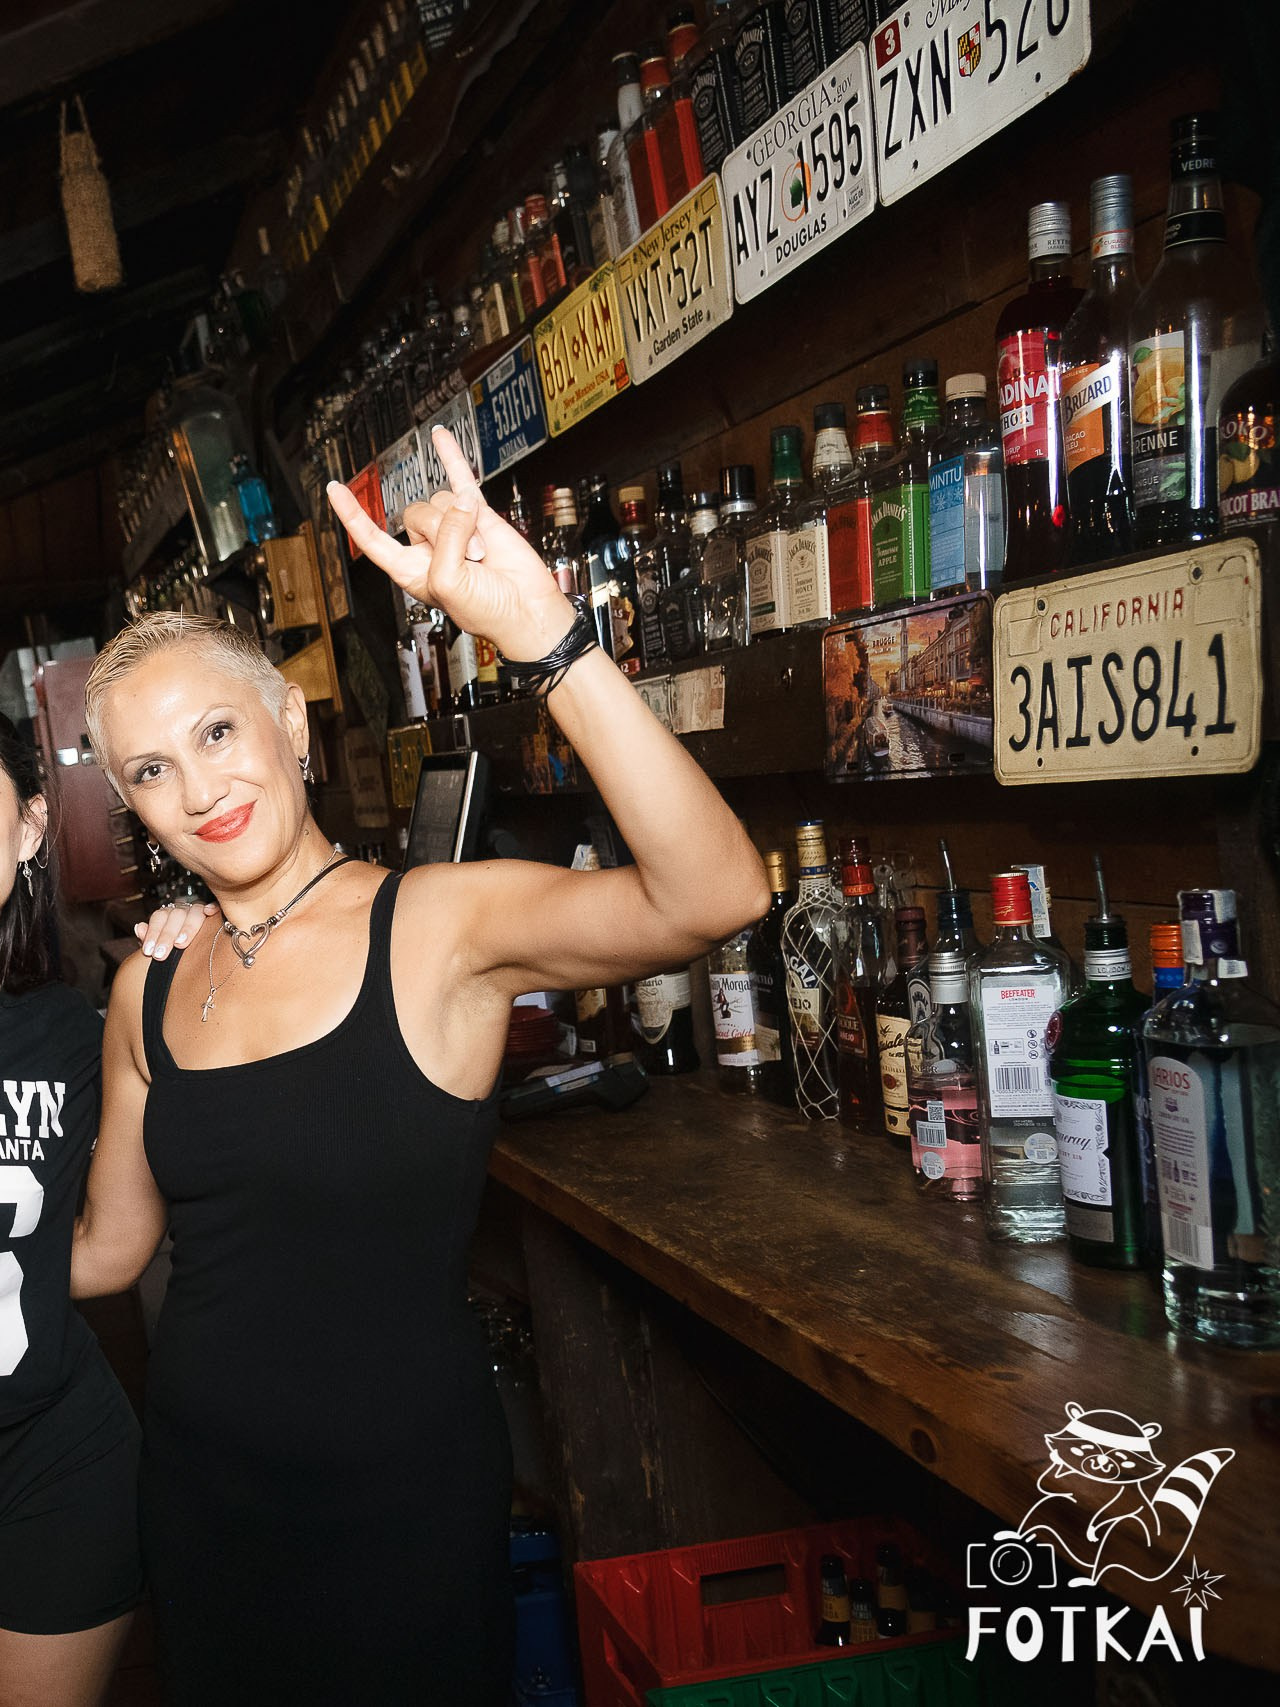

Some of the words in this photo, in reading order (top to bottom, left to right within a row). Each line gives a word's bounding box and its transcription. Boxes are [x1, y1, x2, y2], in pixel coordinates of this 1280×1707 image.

[883, 27, 897, 56] 3
[880, 27, 953, 161] ZXN
[733, 167, 779, 267] AYZ
[796, 90, 865, 215] 1595
[638, 235, 664, 267] New
[660, 209, 694, 258] Jersey
[776, 212, 828, 264] DOUGLAS
[626, 260, 668, 343] VXT
[670, 218, 717, 310] 52T
[541, 326, 576, 402] 861
[576, 286, 619, 373] KAM
[652, 329, 681, 358] Garden
[681, 309, 704, 335] State
[491, 367, 538, 441] 531FCV
[1000, 374, 1050, 407] ADINA
[1064, 374, 1112, 425] BRIZARD
[1135, 430, 1179, 455] RENNE
[882, 501, 908, 522] DANIEL'S
[1251, 489, 1280, 512] BRA
[877, 555, 898, 568] APPLE
[795, 584, 814, 595] HONEY
[1050, 587, 1185, 640] CALIFORNIA
[872, 636, 896, 649] BRUGGE
[1008, 633, 1237, 753] 3AIS841
[1000, 988, 1036, 1000] BEEFEATER
